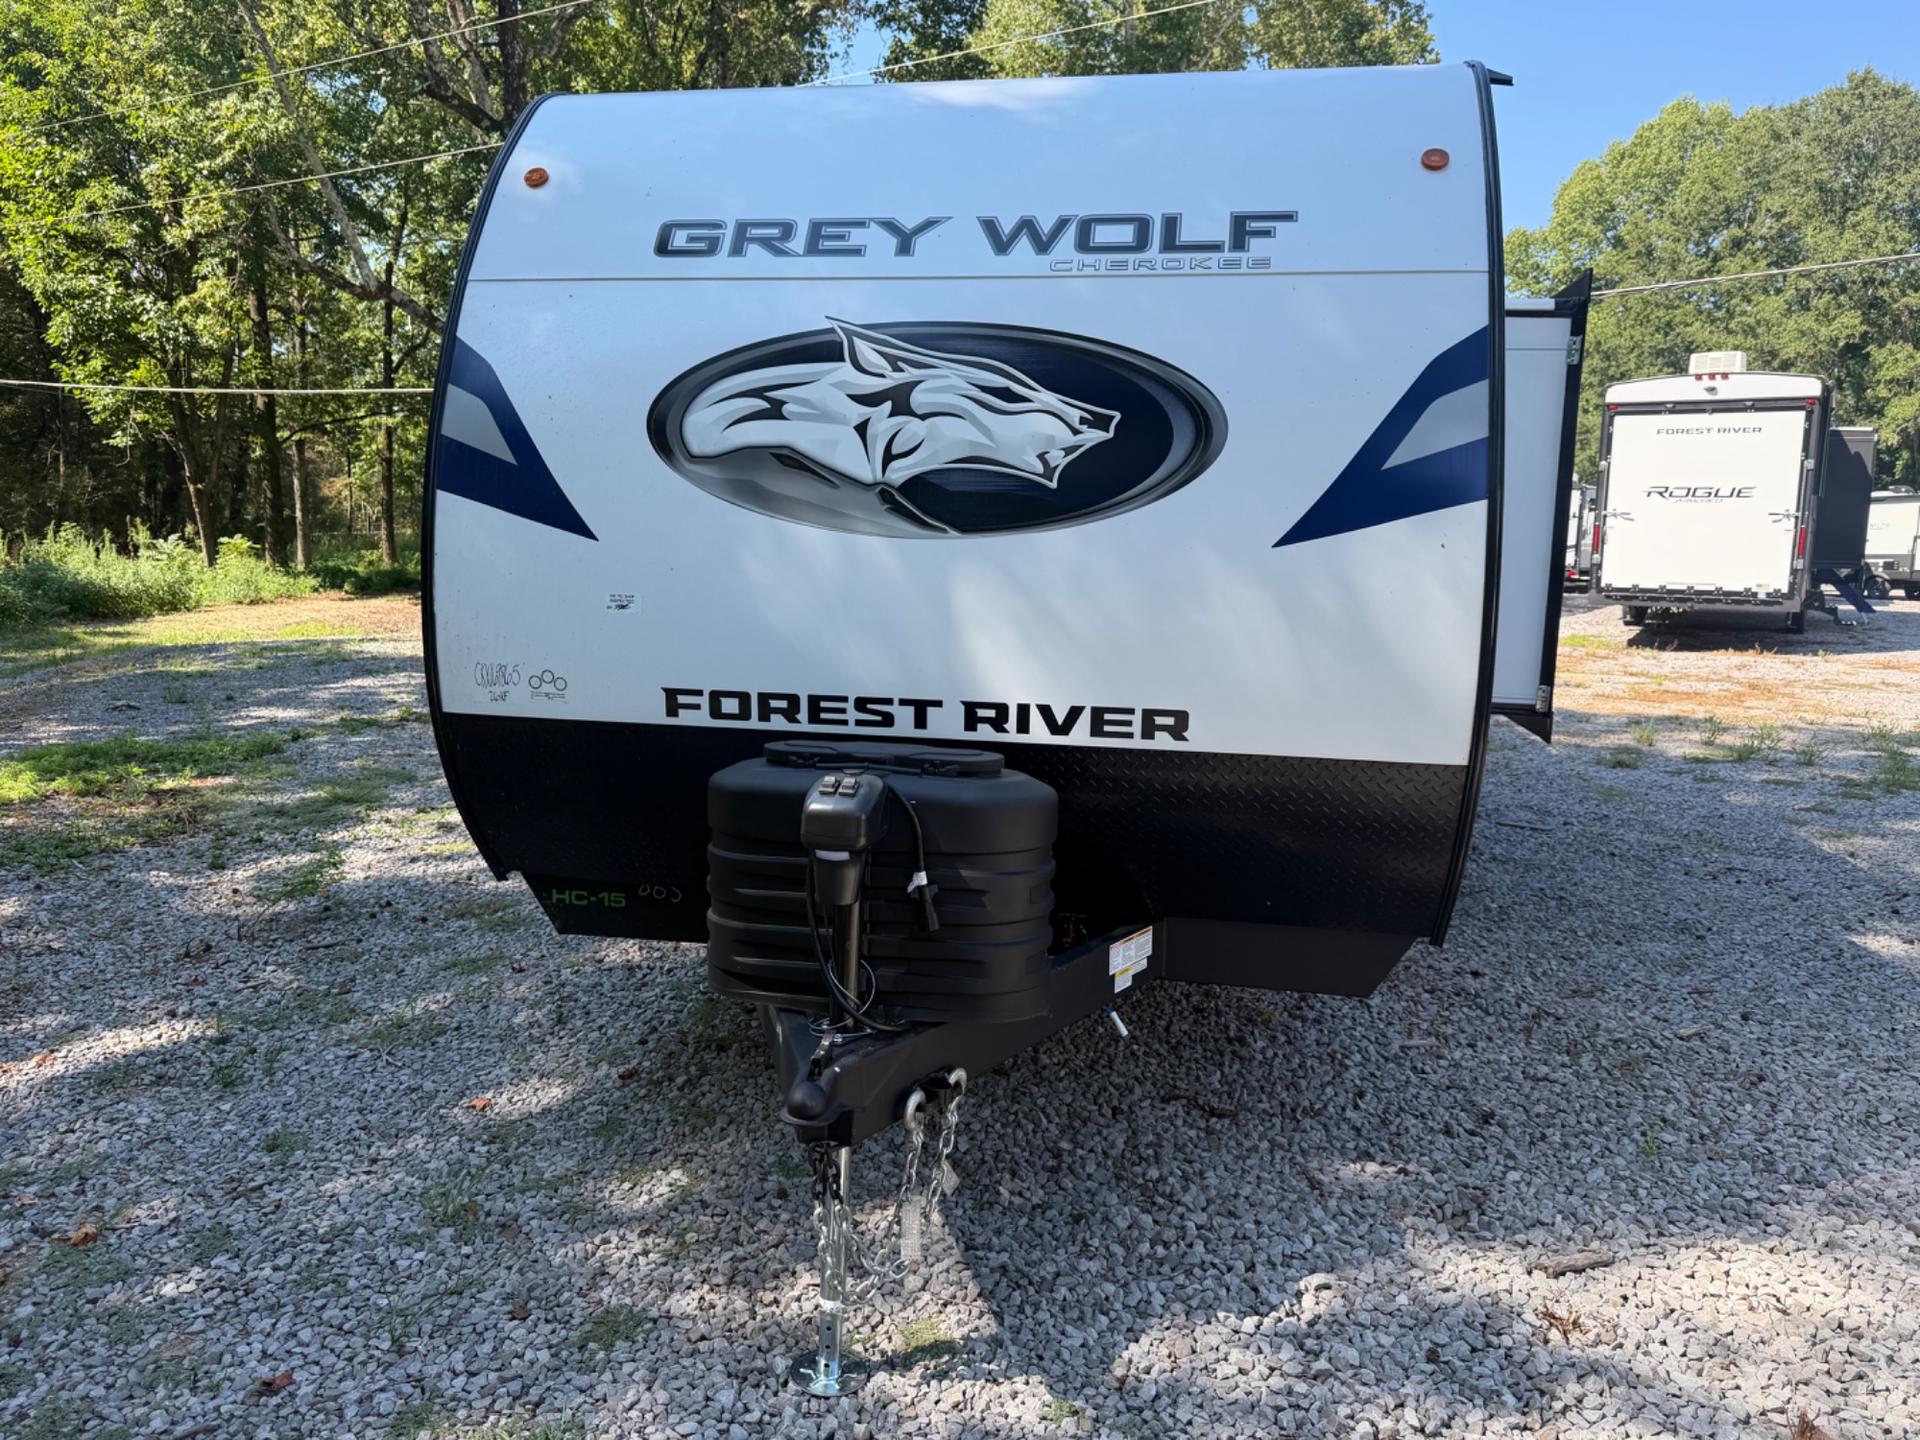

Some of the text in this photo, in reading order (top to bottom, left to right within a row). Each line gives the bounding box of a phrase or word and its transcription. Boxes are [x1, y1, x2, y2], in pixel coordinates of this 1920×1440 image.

[653, 210, 1298, 257] GREY WOLF
[1050, 256, 1272, 272] CHEROKEE
[1656, 426, 1763, 435] FOREST RIVER
[1642, 485, 1757, 500] ROGUE
[661, 686, 1190, 743] FOREST RIVER
[551, 888, 626, 908] HC-15
